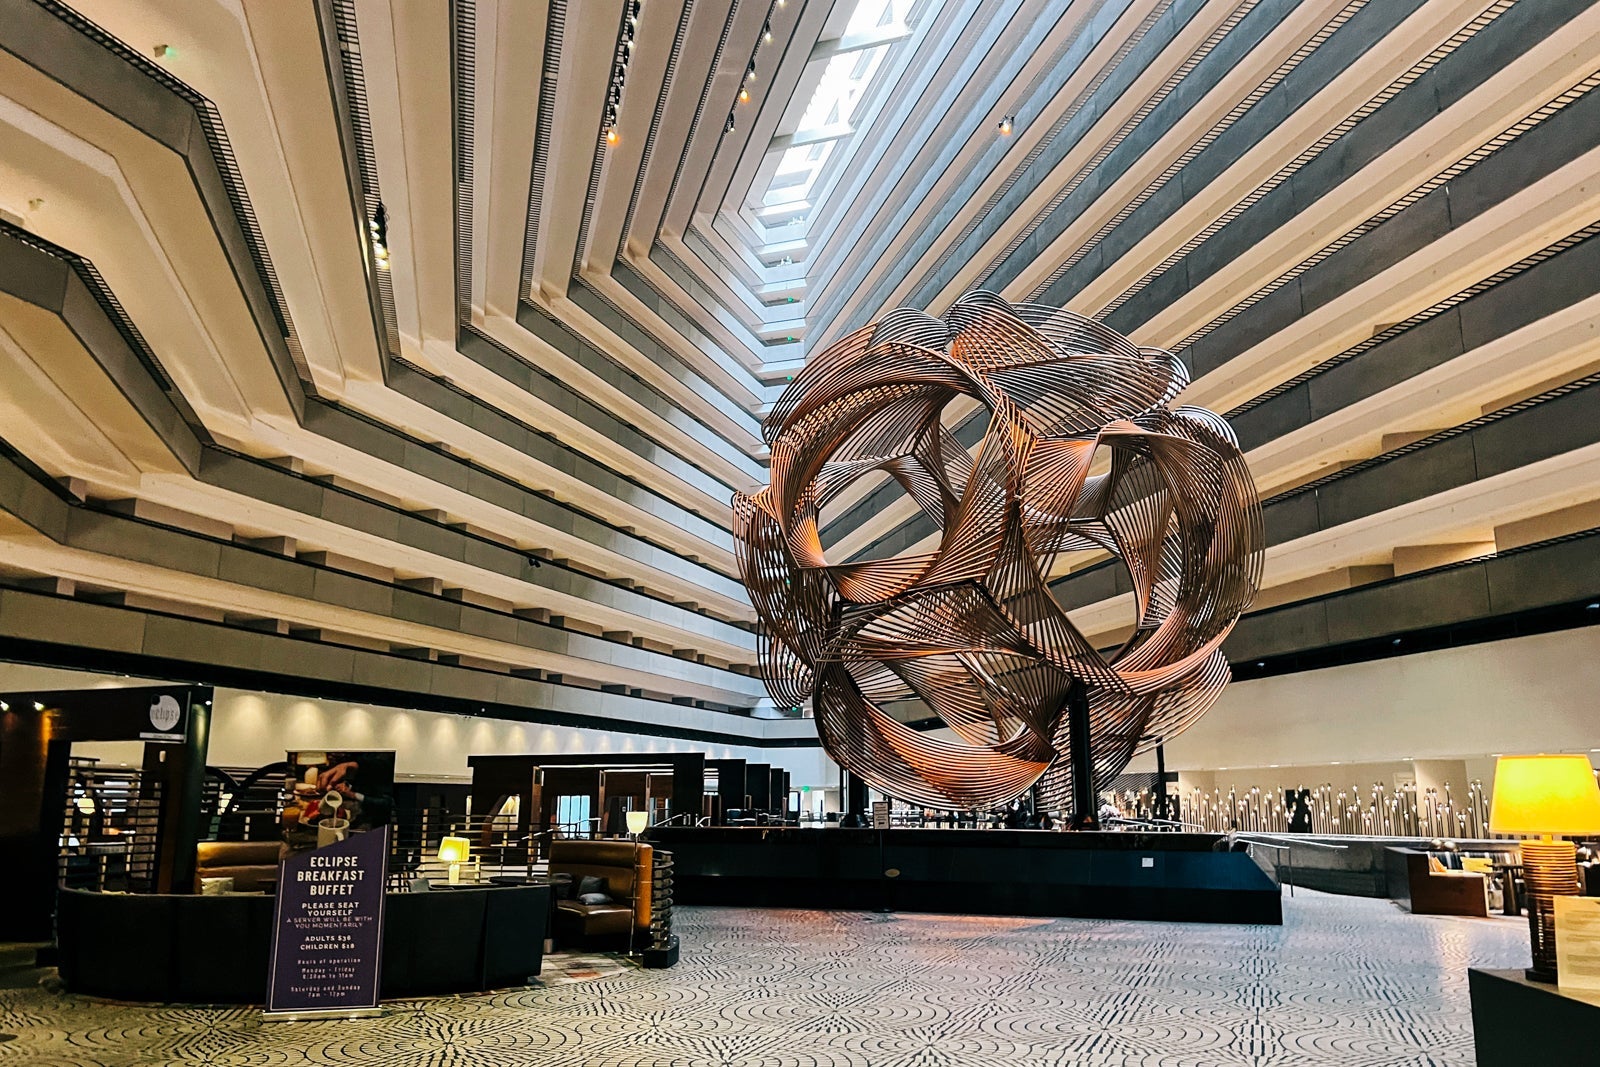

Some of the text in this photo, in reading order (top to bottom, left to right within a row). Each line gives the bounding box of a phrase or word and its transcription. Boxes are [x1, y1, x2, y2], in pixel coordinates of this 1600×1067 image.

[310, 856, 358, 867] ECLIPSE
[297, 870, 365, 881] BREAKFAST
[310, 884, 354, 895] BUFFET
[301, 901, 360, 910] PLEASE SEAT
[307, 909, 353, 917] YOURSELF
